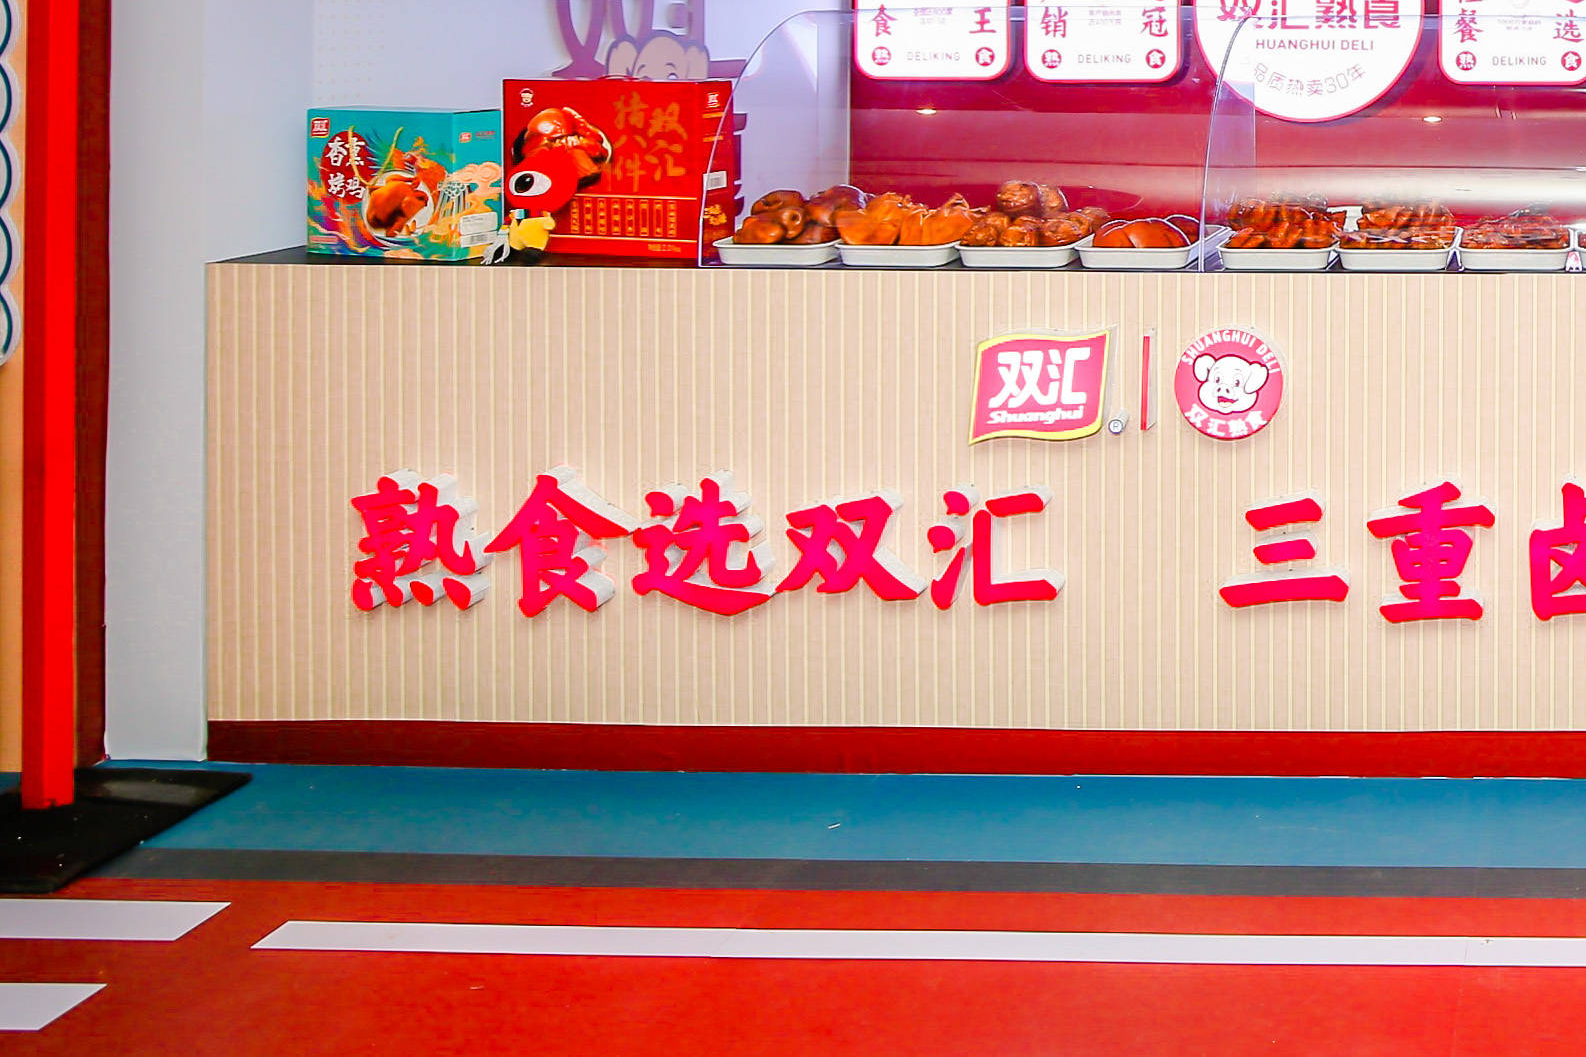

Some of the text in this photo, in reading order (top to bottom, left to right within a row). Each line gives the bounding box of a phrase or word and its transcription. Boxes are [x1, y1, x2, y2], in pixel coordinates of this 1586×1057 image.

[1255, 39, 1374, 51] HUANGHUI DELI
[906, 51, 960, 61] DELIKING
[1078, 54, 1131, 64] DELIKING
[1492, 55, 1547, 66] DELIKING
[1181, 330, 1281, 374] SHUANGHUI DELI
[987, 347, 1091, 409] 双汇
[987, 405, 1084, 425] Shuanghui
[350, 474, 1060, 618] 熟食选双汇
